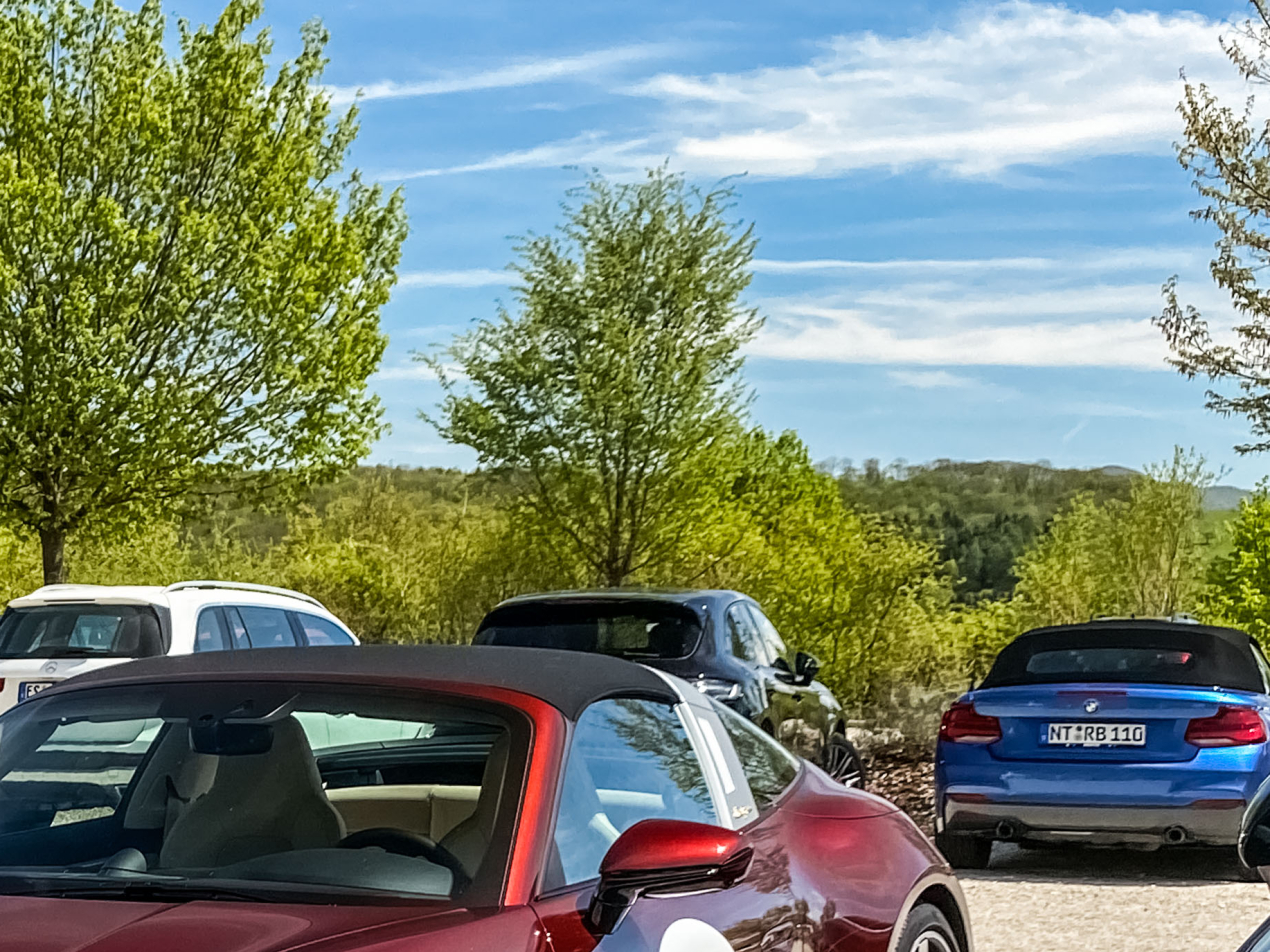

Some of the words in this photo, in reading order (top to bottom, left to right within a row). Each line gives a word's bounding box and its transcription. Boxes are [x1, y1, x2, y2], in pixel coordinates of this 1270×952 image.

[1050, 726, 1072, 740] NT
[1084, 726, 1106, 741] RB
[1110, 727, 1142, 741] 110
